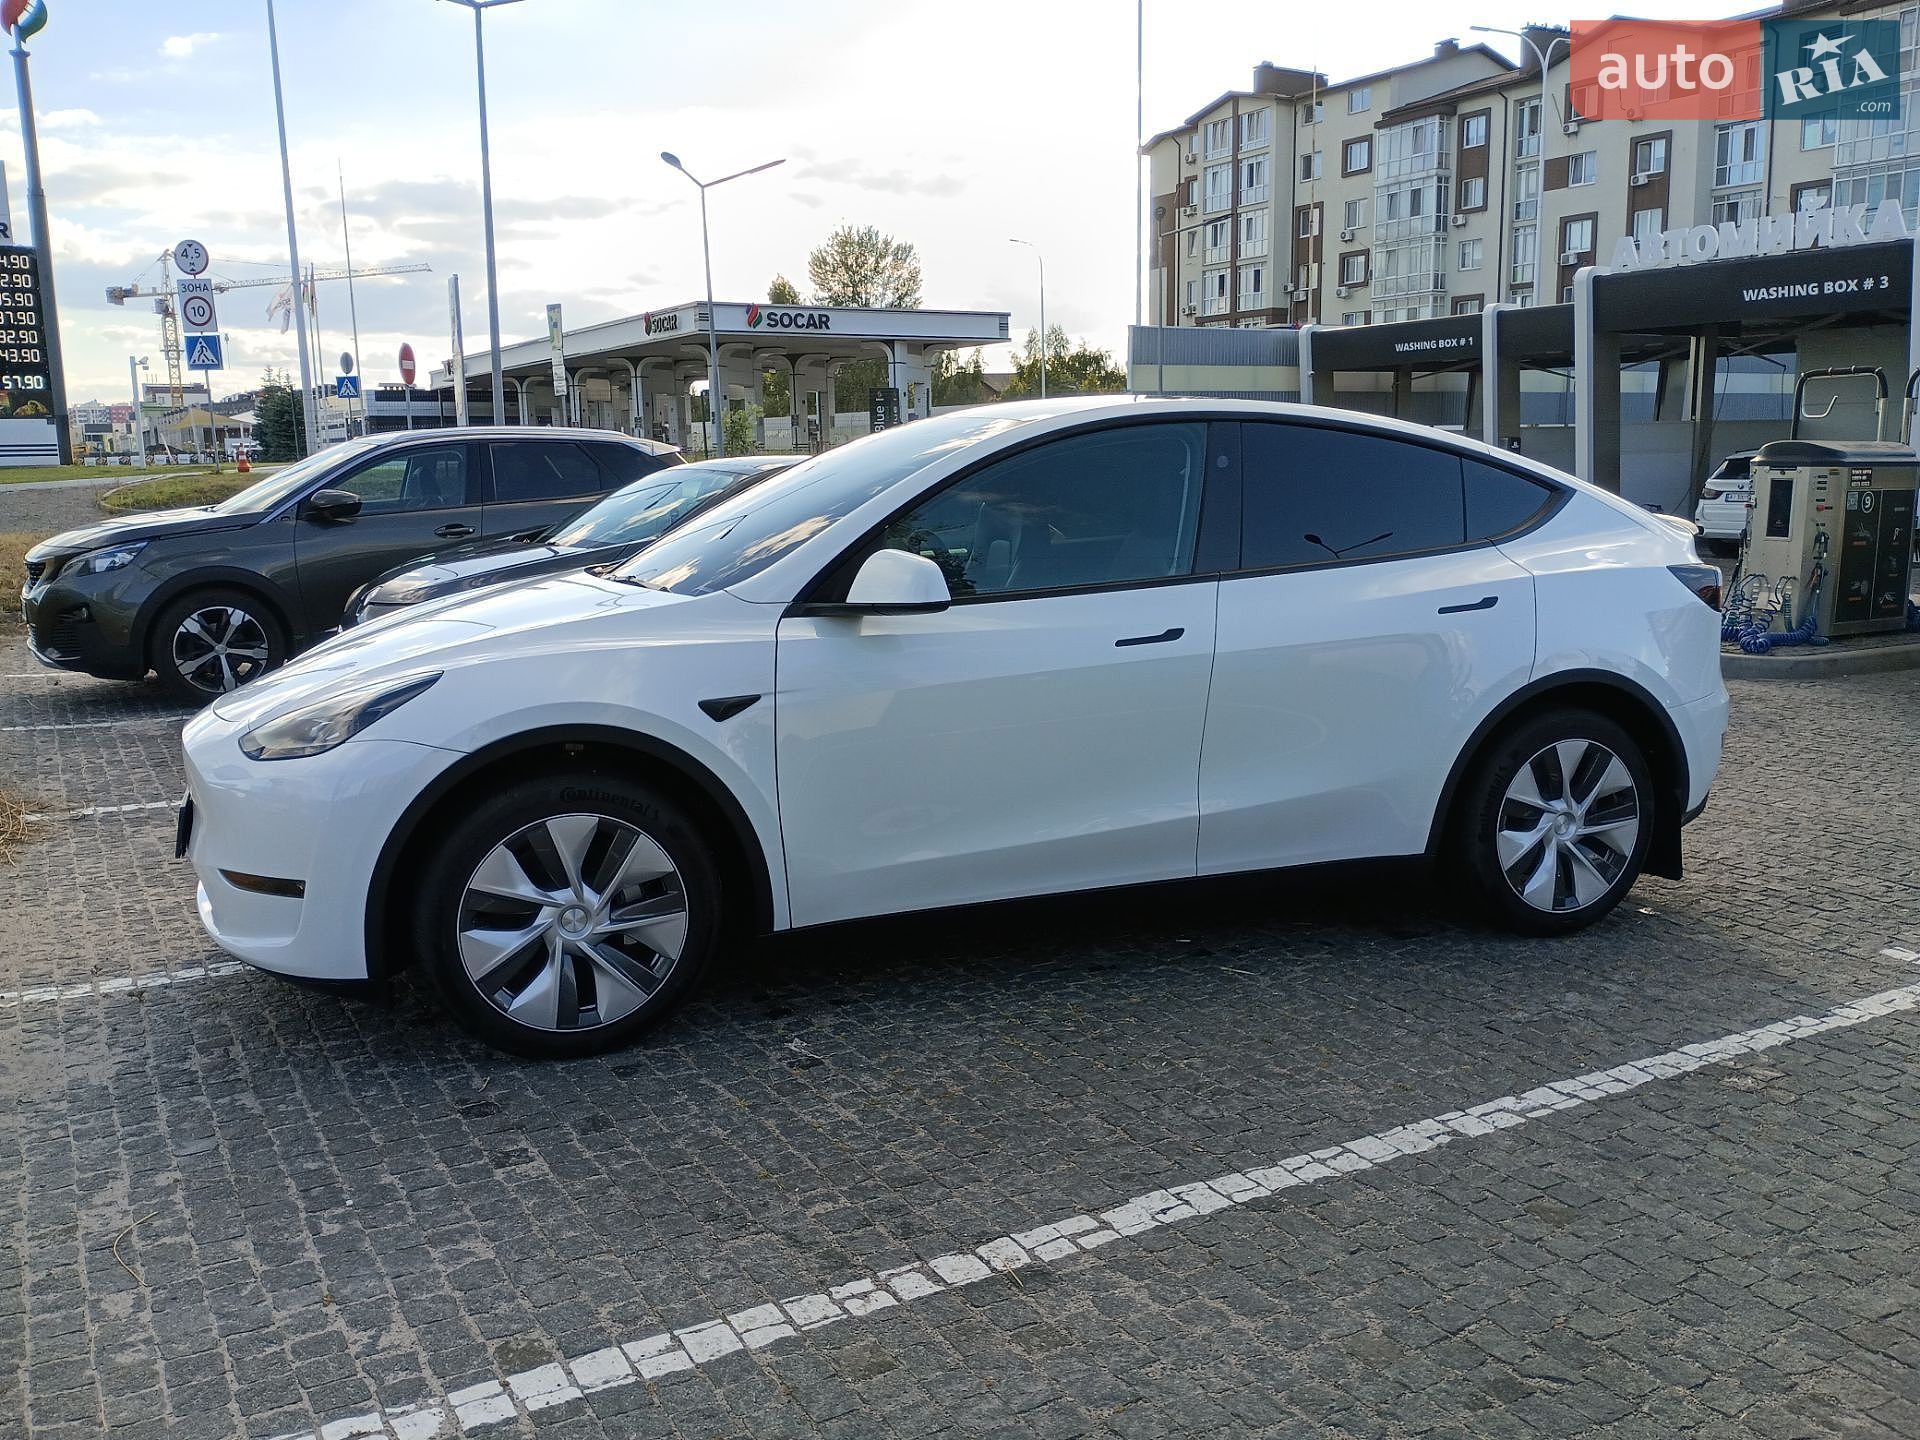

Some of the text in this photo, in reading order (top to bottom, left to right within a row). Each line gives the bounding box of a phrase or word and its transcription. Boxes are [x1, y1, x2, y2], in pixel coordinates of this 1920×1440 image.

[1610, 198, 1906, 272] АВТОМИЙКА
[181, 283, 210, 293] ЗОНА
[1743, 275, 1889, 302] WASHING BOX # 3
[0, 292, 34, 307] 5.90
[191, 305, 206, 318] 10
[652, 313, 678, 334] SOCAR
[766, 311, 831, 330] SOCAR
[1395, 336, 1473, 352] WASHING BOX # 1
[0, 349, 40, 363] 43.90
[2, 375, 43, 390] 57.90
[1864, 497, 1871, 508] 9
